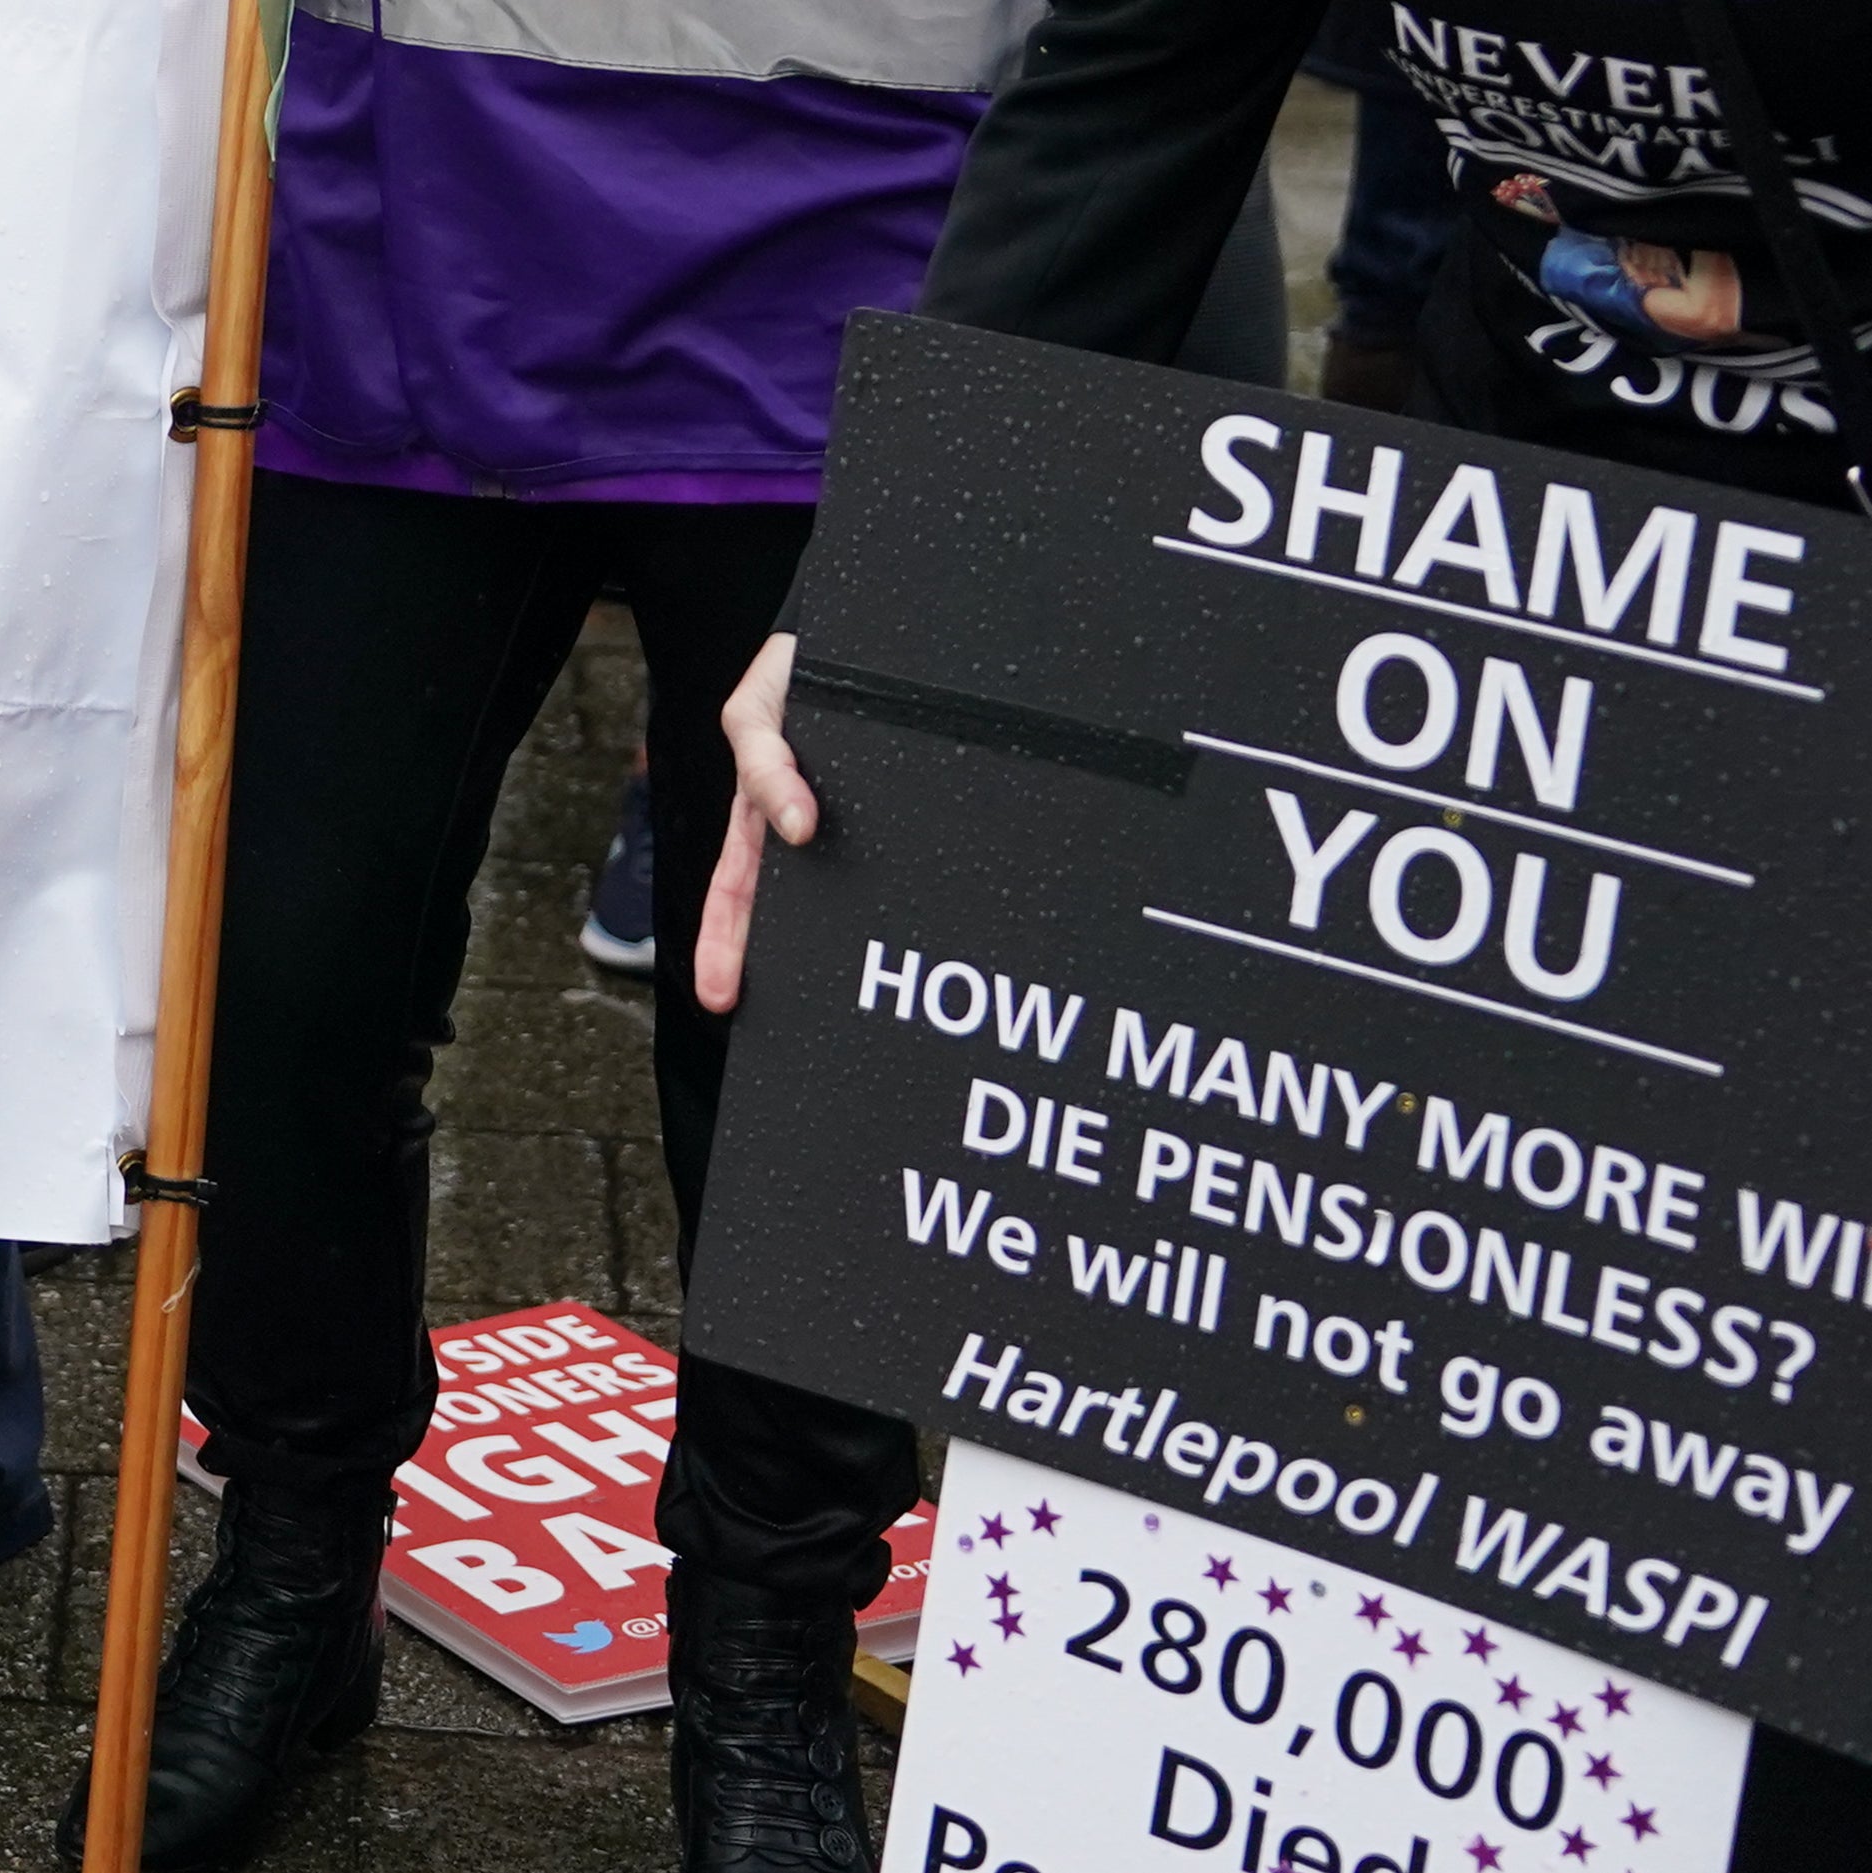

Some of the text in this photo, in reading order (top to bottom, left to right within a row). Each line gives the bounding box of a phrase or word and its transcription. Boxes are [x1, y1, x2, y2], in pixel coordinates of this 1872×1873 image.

[1186, 413, 1806, 672] SHAME
[1336, 632, 1594, 811] ON
[1263, 787, 1622, 1001] YOU
[857, 940, 1083, 1062] HOW
[1104, 1005, 1396, 1150] MANY
[1417, 1094, 1705, 1252] MORE
[961, 1076, 1109, 1189] DIE
[435, 1314, 619, 1381] SIDE
[901, 1167, 1855, 1557] We will not go away
[941, 1331, 1770, 1671] Hartlepool WASPI
[1064, 1568, 1566, 1833] 280,000
